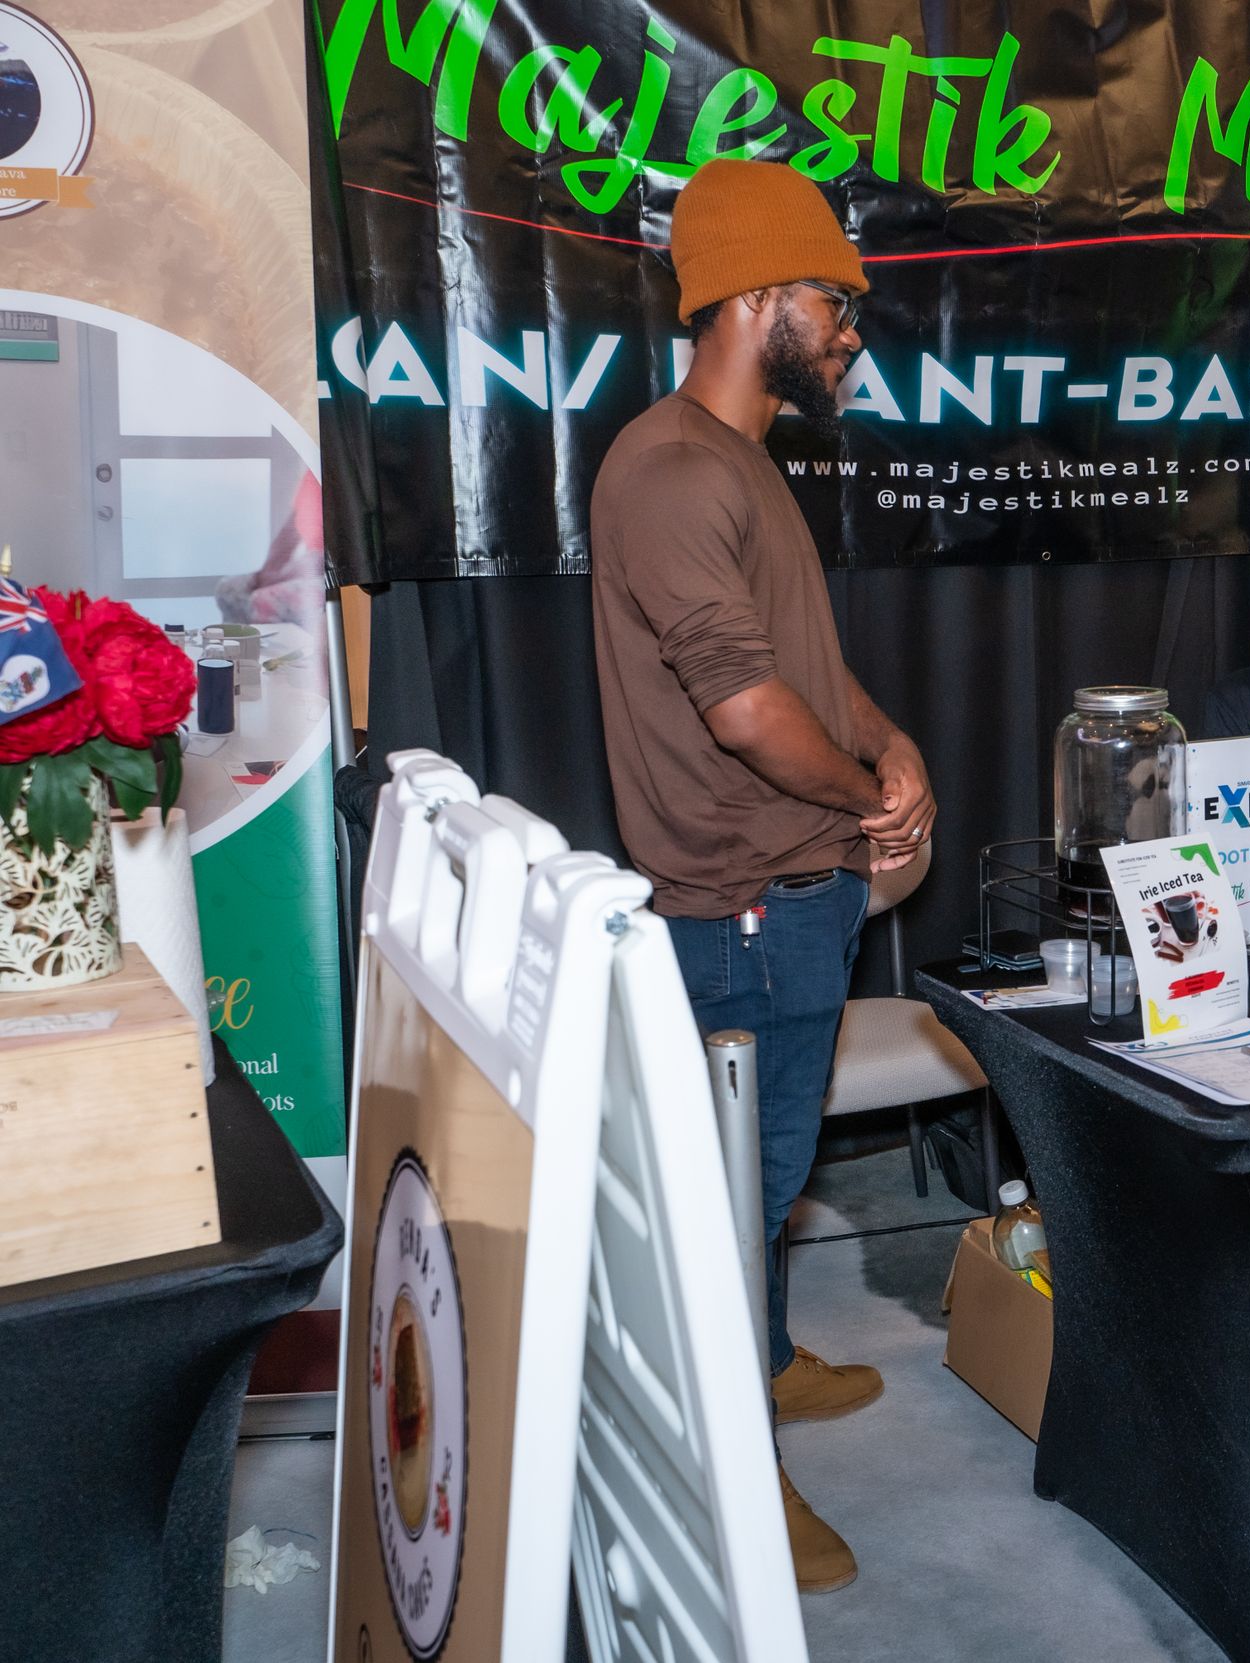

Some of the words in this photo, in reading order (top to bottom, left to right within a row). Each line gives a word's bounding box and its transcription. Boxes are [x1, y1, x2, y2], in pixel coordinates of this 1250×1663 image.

[877, 487, 1189, 515] @majestikmealz
[1139, 886, 1159, 901] Irie
[1159, 876, 1183, 893] Iced
[1182, 872, 1204, 884] Tea
